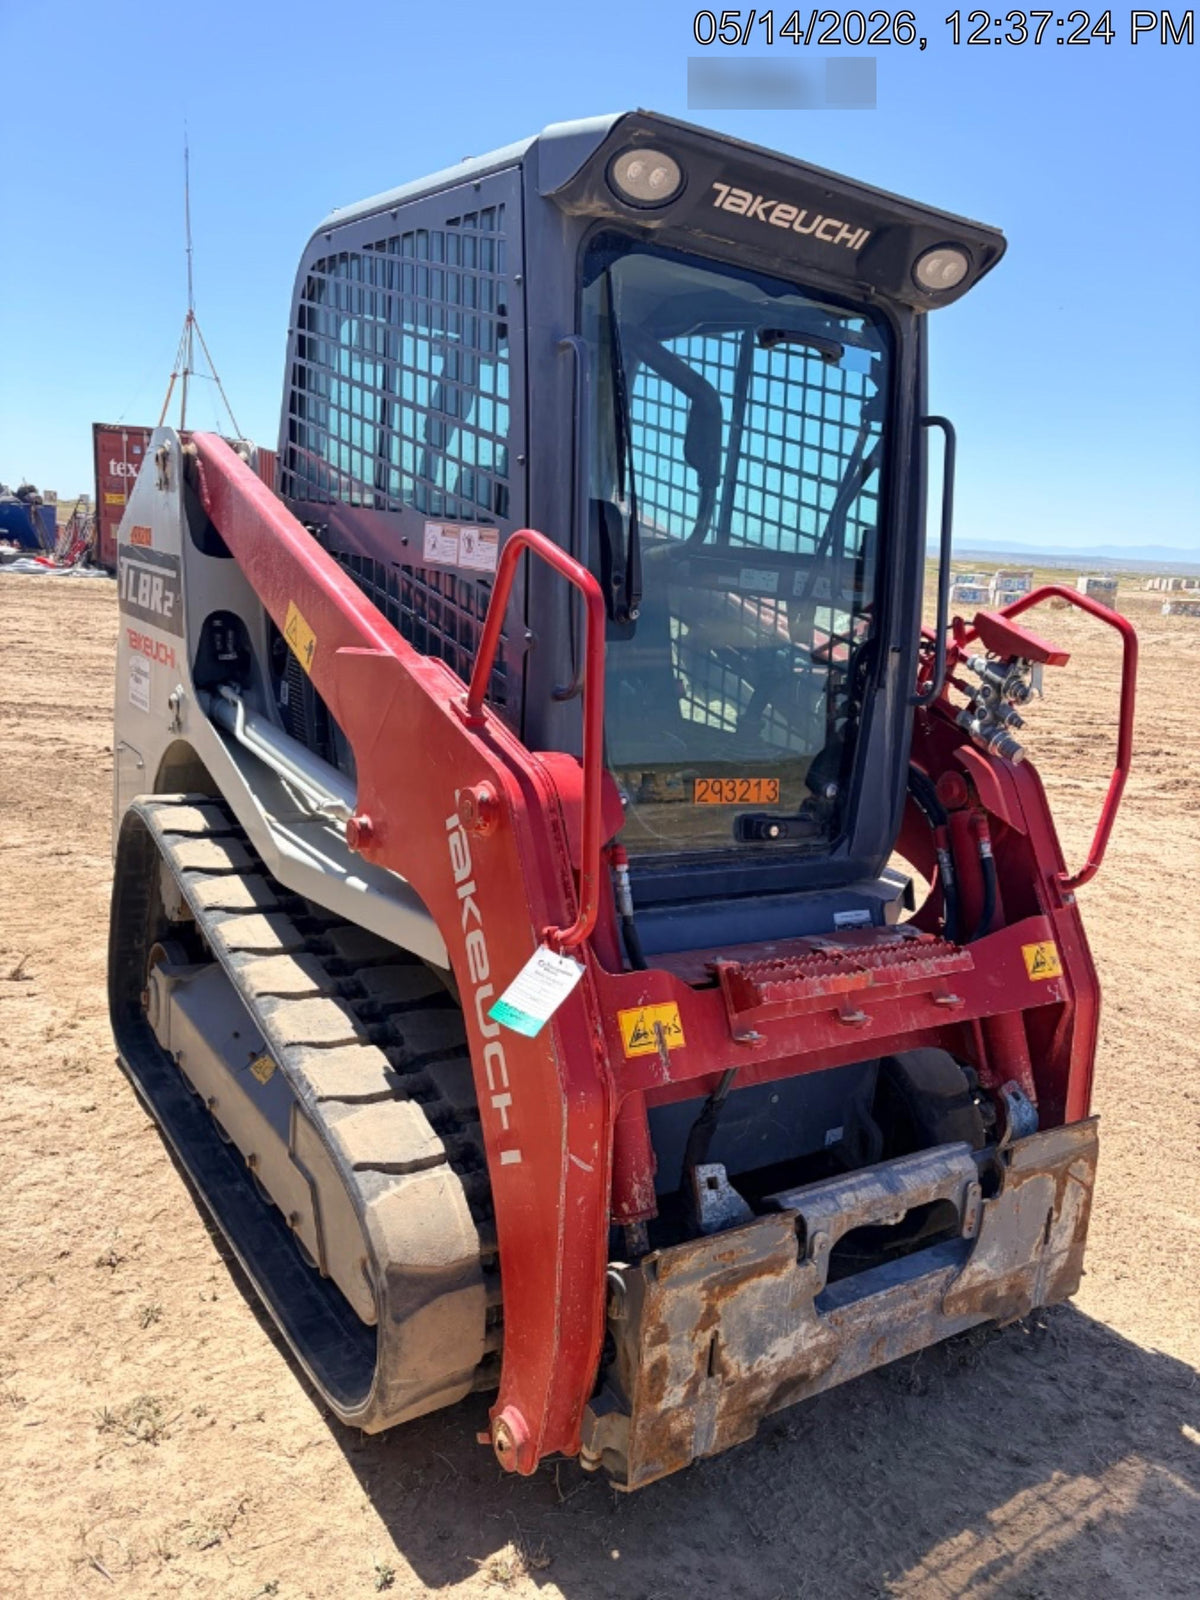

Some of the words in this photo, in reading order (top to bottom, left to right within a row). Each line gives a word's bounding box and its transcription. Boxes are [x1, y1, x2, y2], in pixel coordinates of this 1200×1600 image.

[712, 182, 871, 250] TAKEUCHI
[109, 459, 139, 477] tex
[696, 779, 778, 803] 293213
